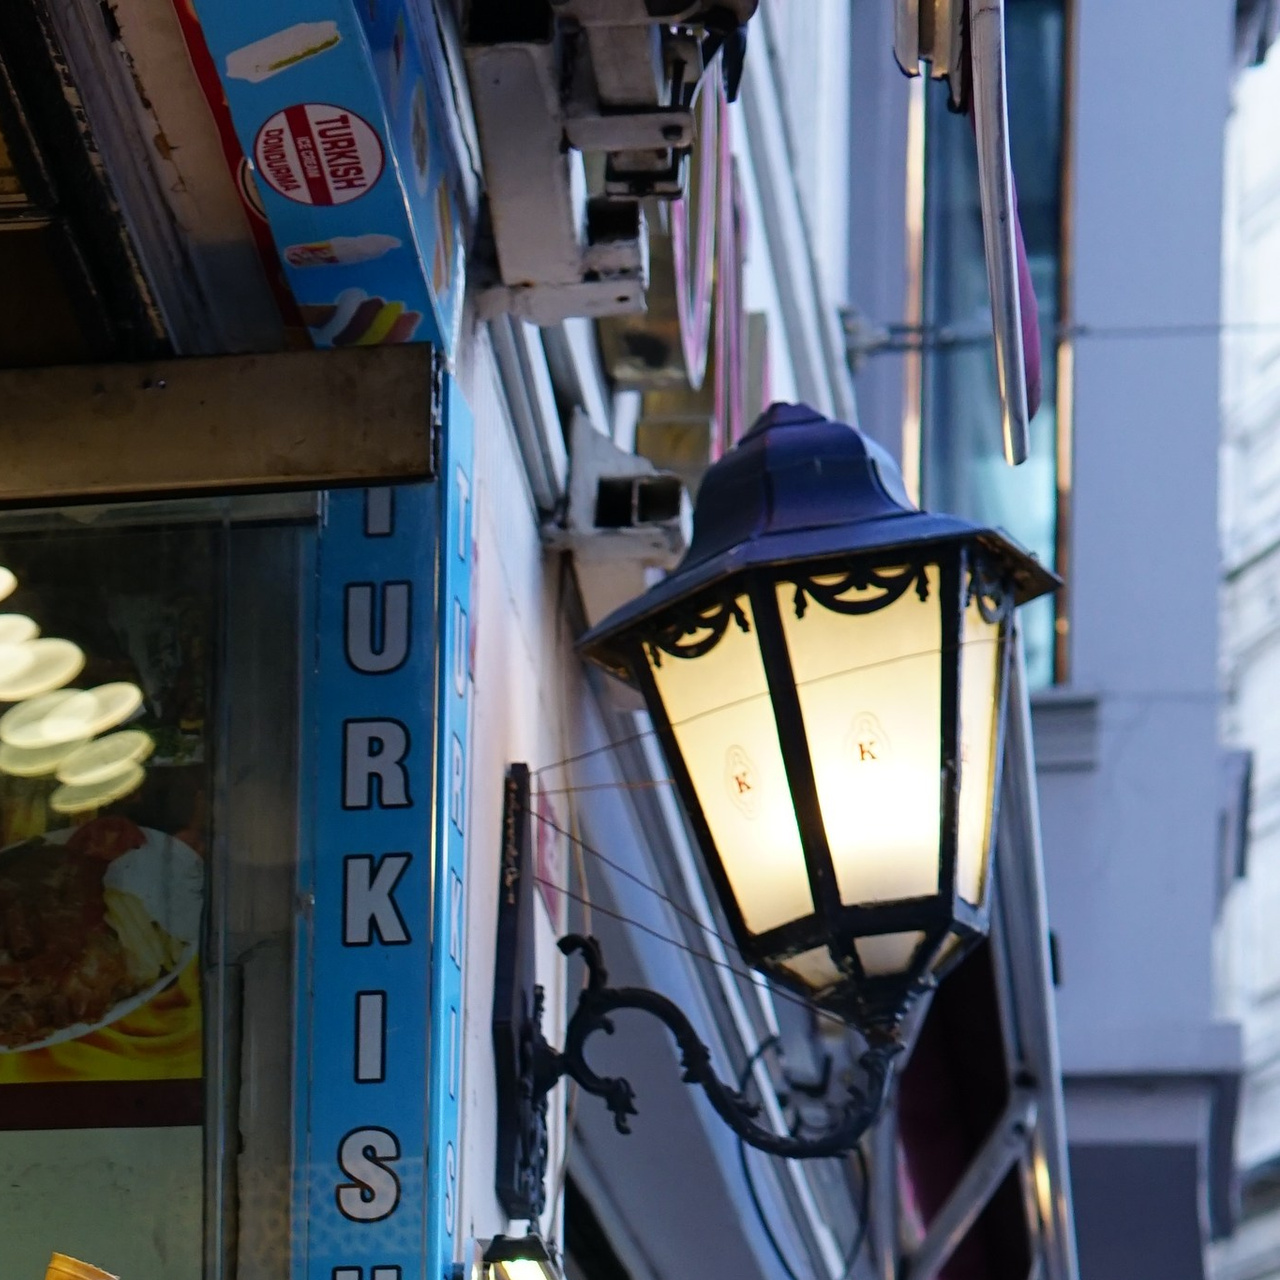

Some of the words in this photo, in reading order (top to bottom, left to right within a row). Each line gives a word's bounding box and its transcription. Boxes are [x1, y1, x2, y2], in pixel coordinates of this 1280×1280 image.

[263, 127, 301, 192] DONDURMA
[295, 135, 312, 152] ICE
[315, 113, 367, 191] TURKISH
